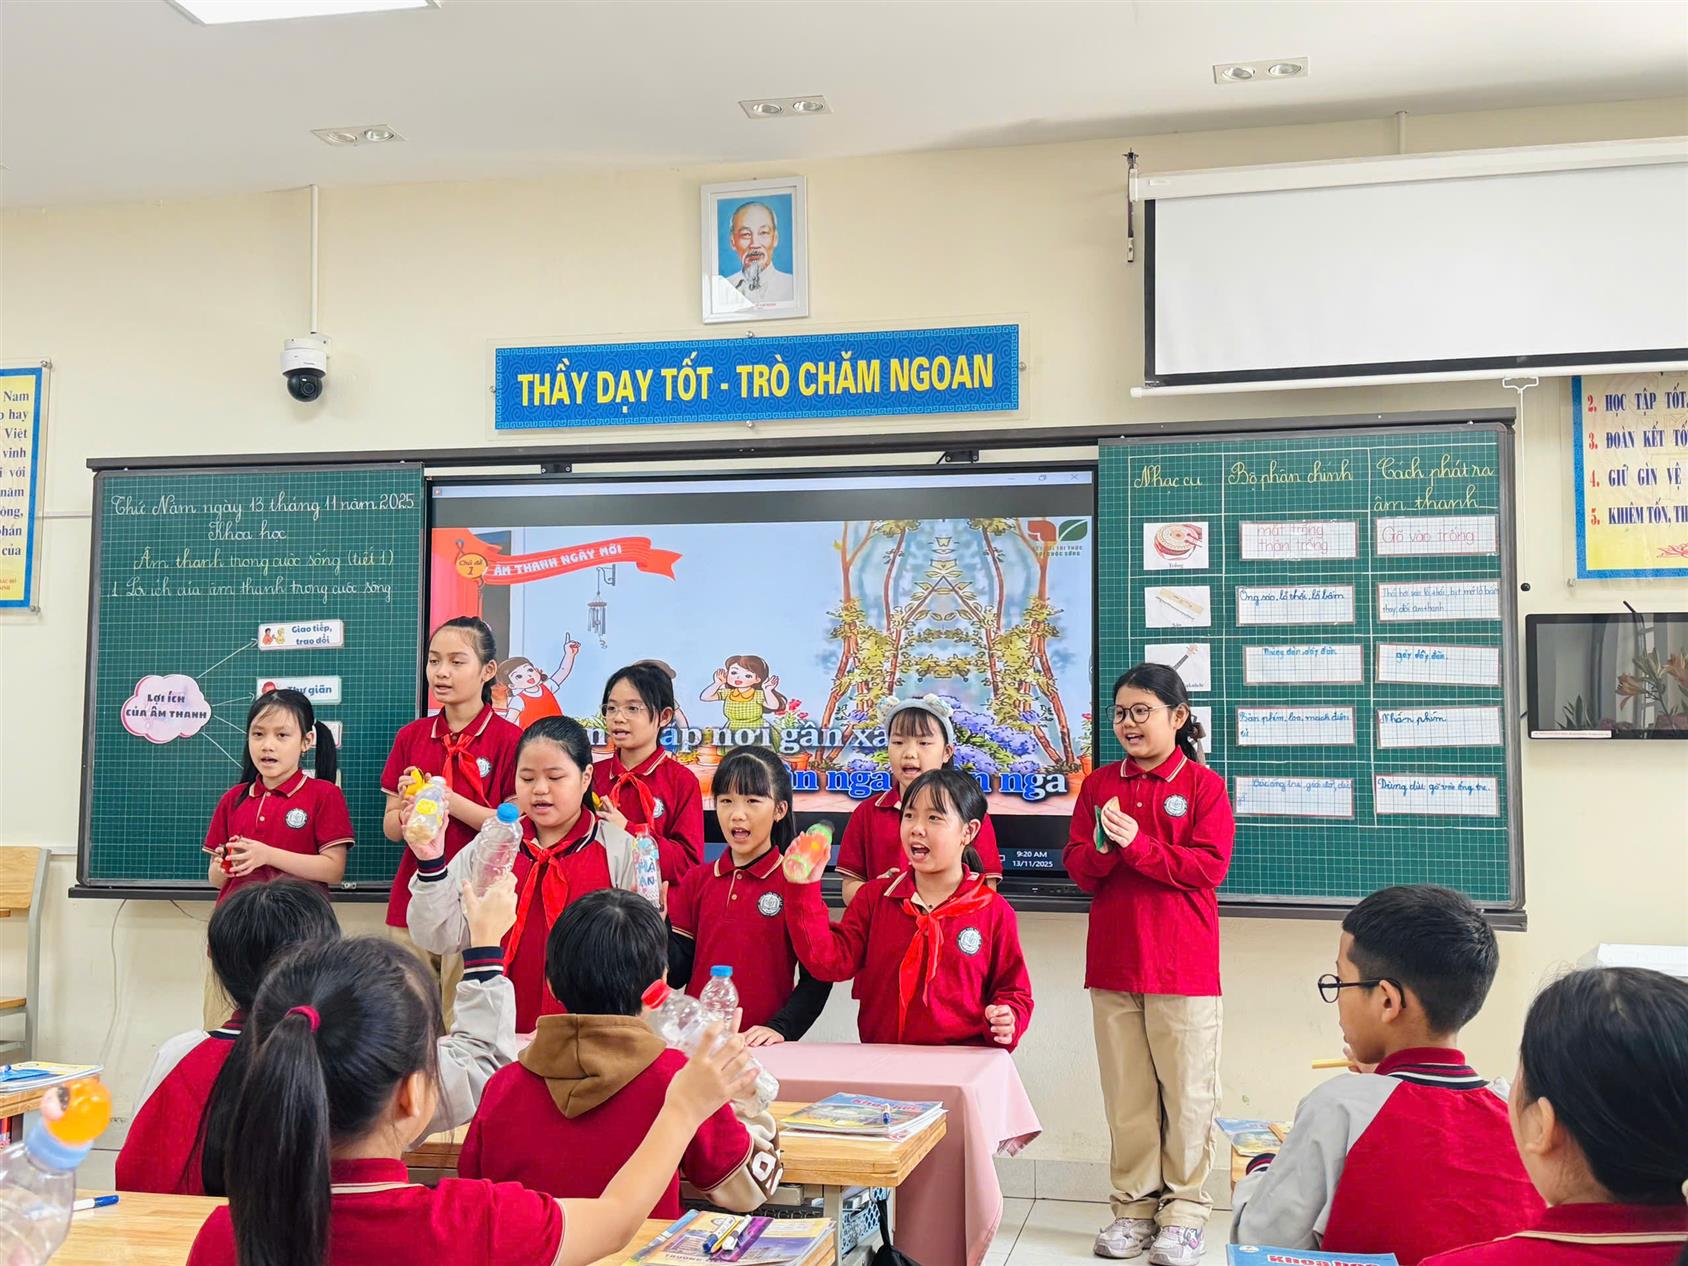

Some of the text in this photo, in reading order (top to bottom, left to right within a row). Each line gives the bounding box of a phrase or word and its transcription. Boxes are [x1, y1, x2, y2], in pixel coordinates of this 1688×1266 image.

[517, 358, 589, 406] THẦY
[597, 369, 653, 414] DẠY
[661, 351, 713, 401] TỐT
[736, 354, 790, 398] TRÒ
[798, 351, 880, 396] CHĂM
[890, 353, 993, 392] NGOAN
[4, 391, 29, 402] Nam
[1588, 395, 1597, 412] 2.
[1605, 394, 1626, 417] HỌC
[1635, 387, 1656, 416] TẬP
[9, 409, 28, 422] hay
[5, 428, 27, 441] Việt
[1589, 432, 1598, 449] 3.
[1606, 426, 1635, 449] ĐOÀN
[1643, 421, 1665, 447] KẾT
[3, 447, 26, 458] vinh
[10, 466, 25, 477] với
[1134, 464, 1202, 494] Nhạc cụ
[1228, 459, 1353, 491] Bộ phận chính
[1376, 454, 1495, 487] Cách phát ra
[1590, 462, 1681, 490] 4. GIỮ GÌN VỆ
[111, 491, 414, 523] Thứ Năm ngày 13 tháng 11 năm 2025
[1374, 484, 1478, 511] âm thanh
[1591, 508, 1600, 525] 5.
[1608, 501, 1644, 525] KHIÊM
[1647, 497, 1671, 528] TỐN,
[208, 520, 287, 542] Khoa học
[1409, 530, 1431, 542] vào
[1438, 527, 1474, 545] trống
[2, 544, 21, 556] của
[1297, 537, 1328, 554] trống
[134, 546, 394, 576] Âm thanh trong cuộc sống (tiết 1)
[494, 564, 511, 576] ÂM
[514, 558, 557, 575] THANH
[560, 549, 595, 565] NGÀY
[177, 580, 201, 596] của
[209, 582, 234, 596] âm
[241, 576, 284, 595] thanh
[291, 580, 328, 604] trong
[364, 578, 392, 603] sống
[147, 691, 185, 704] LỢI ÍCH
[308, 684, 332, 696] giãn
[126, 706, 147, 717] CỦA
[150, 706, 166, 717] ÂM
[712, 723, 771, 747] nơi
[827, 770, 892, 799] nga
[999, 772, 1067, 800] nga
